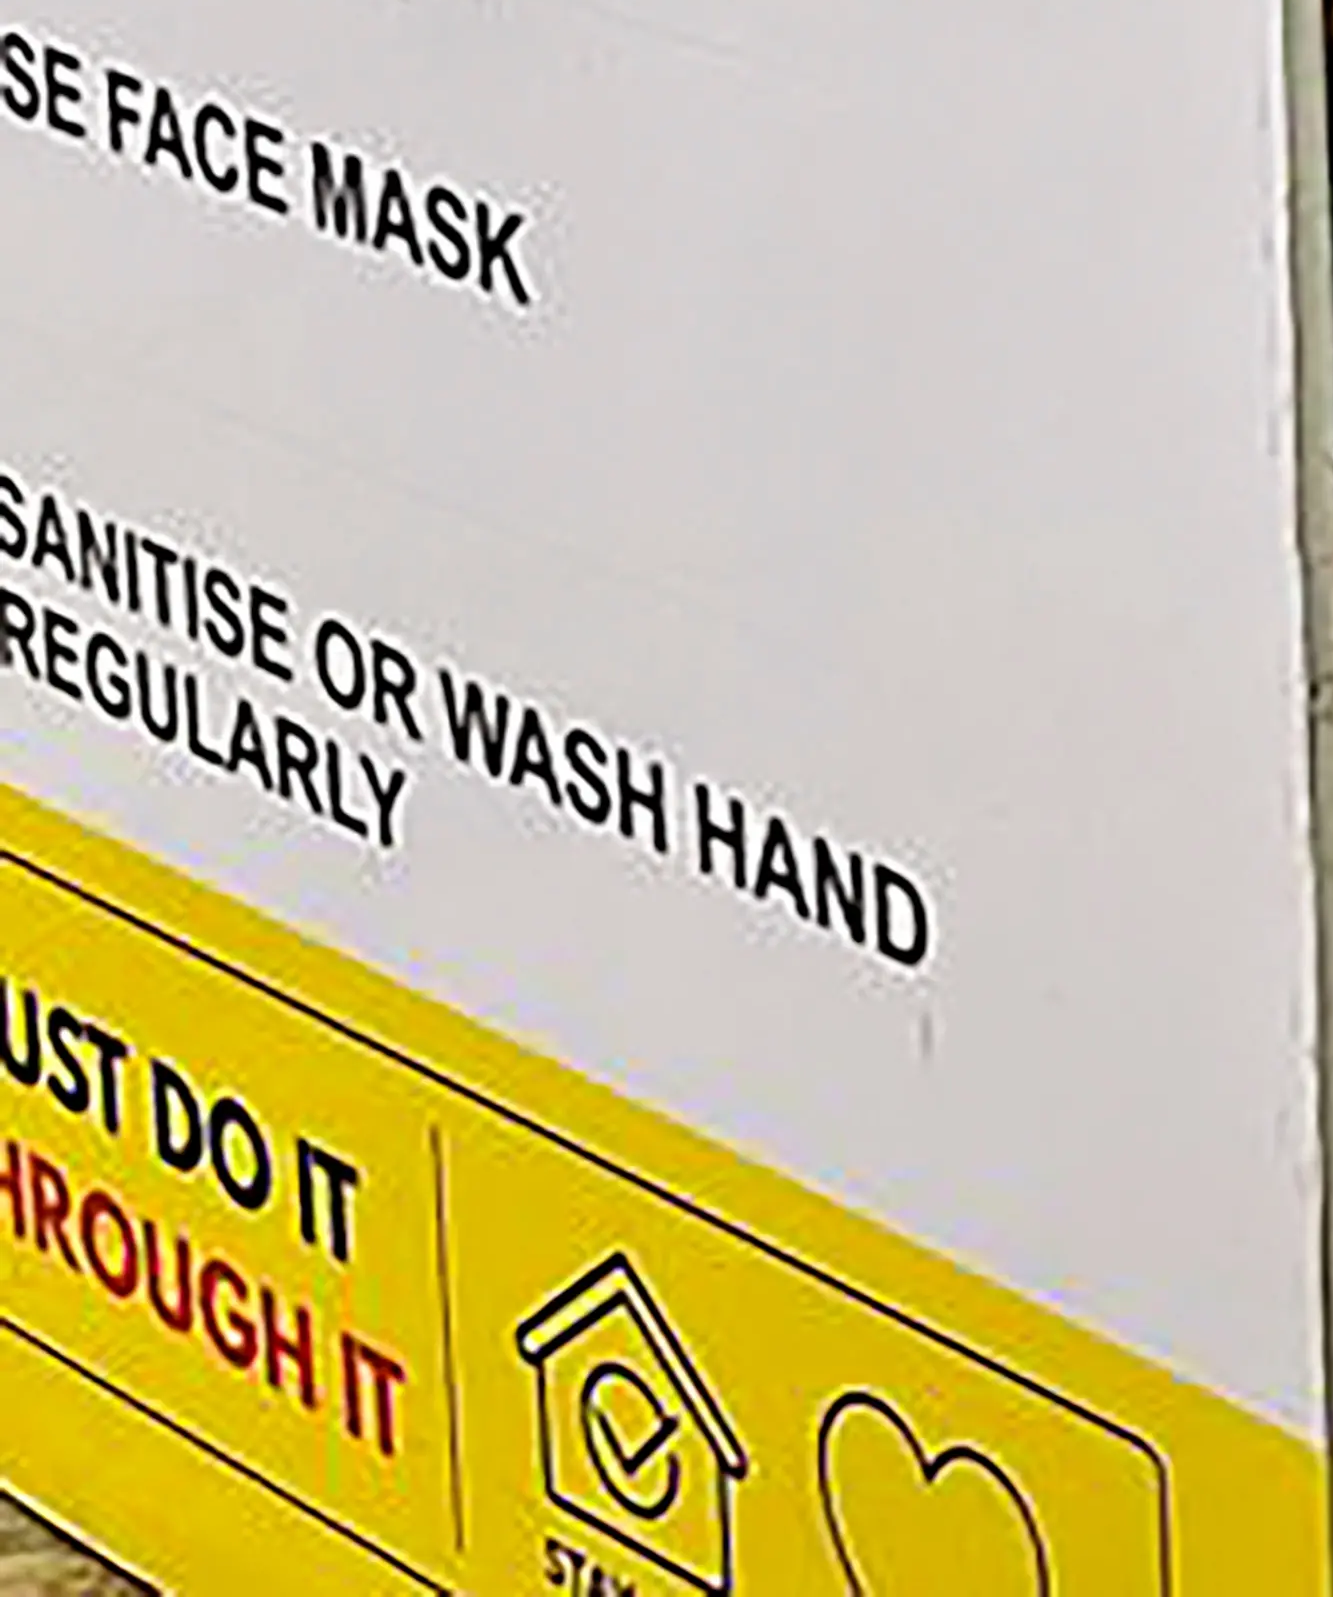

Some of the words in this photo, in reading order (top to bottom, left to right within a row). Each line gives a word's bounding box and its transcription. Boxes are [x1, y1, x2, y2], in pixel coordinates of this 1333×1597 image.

[0, 33, 85, 137] SE
[107, 70, 288, 214] FACE
[312, 143, 529, 304] MASK
[0, 586, 404, 847] REGULARLY
[0, 476, 292, 681] SANITISE
[316, 620, 422, 741] OR
[439, 670, 667, 853] WASH
[696, 784, 927, 966] HAND
[152, 1059, 270, 1210] DO
[297, 1138, 357, 1262] IT
[341, 1331, 406, 1458] IT
